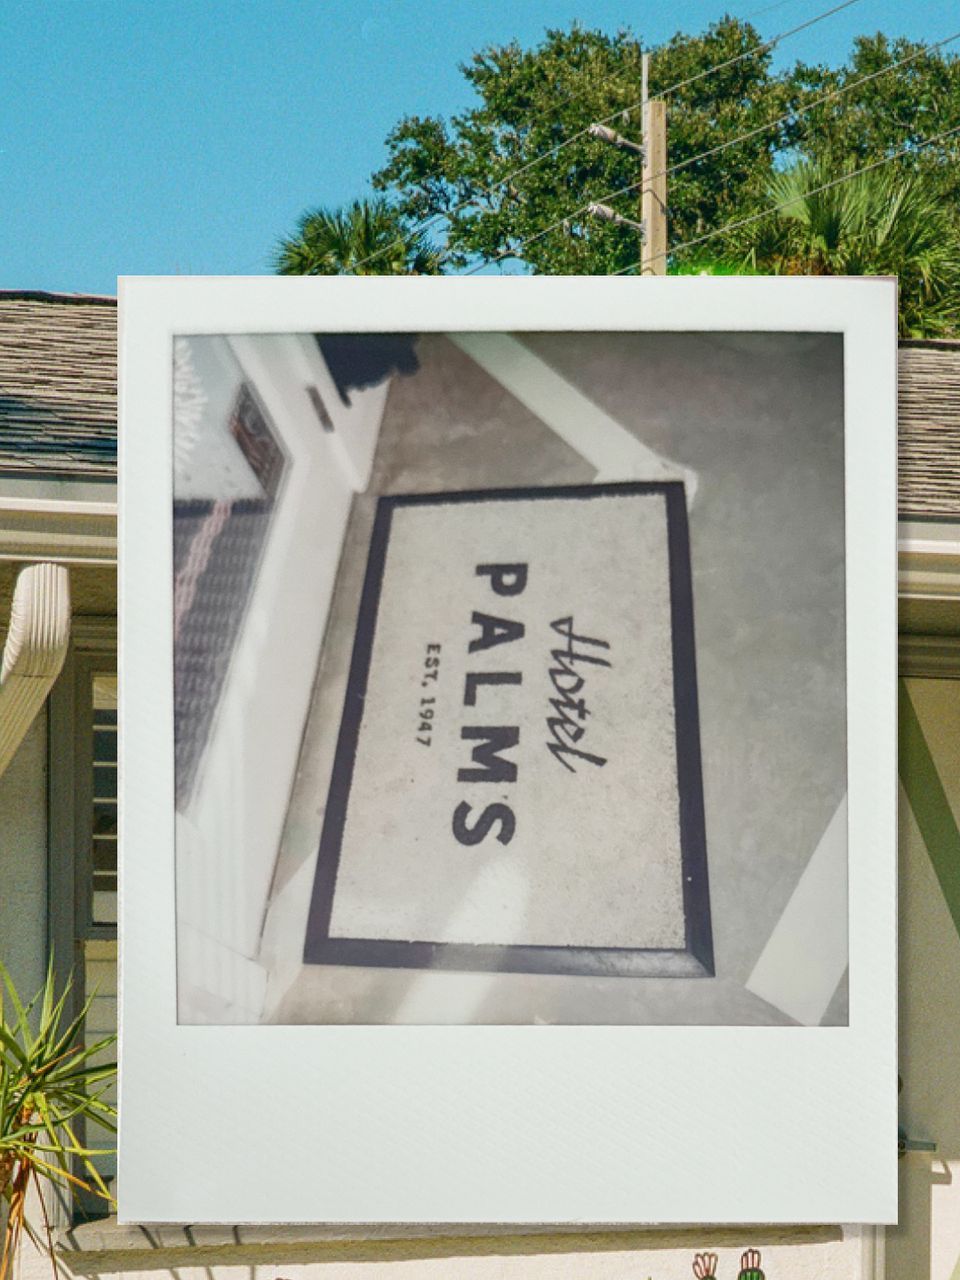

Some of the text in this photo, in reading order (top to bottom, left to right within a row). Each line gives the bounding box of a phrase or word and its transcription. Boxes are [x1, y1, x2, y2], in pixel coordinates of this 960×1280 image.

[416, 643, 441, 747] EST. 1947
[452, 563, 528, 846] PALMS
[549, 616, 612, 773] Hotel
